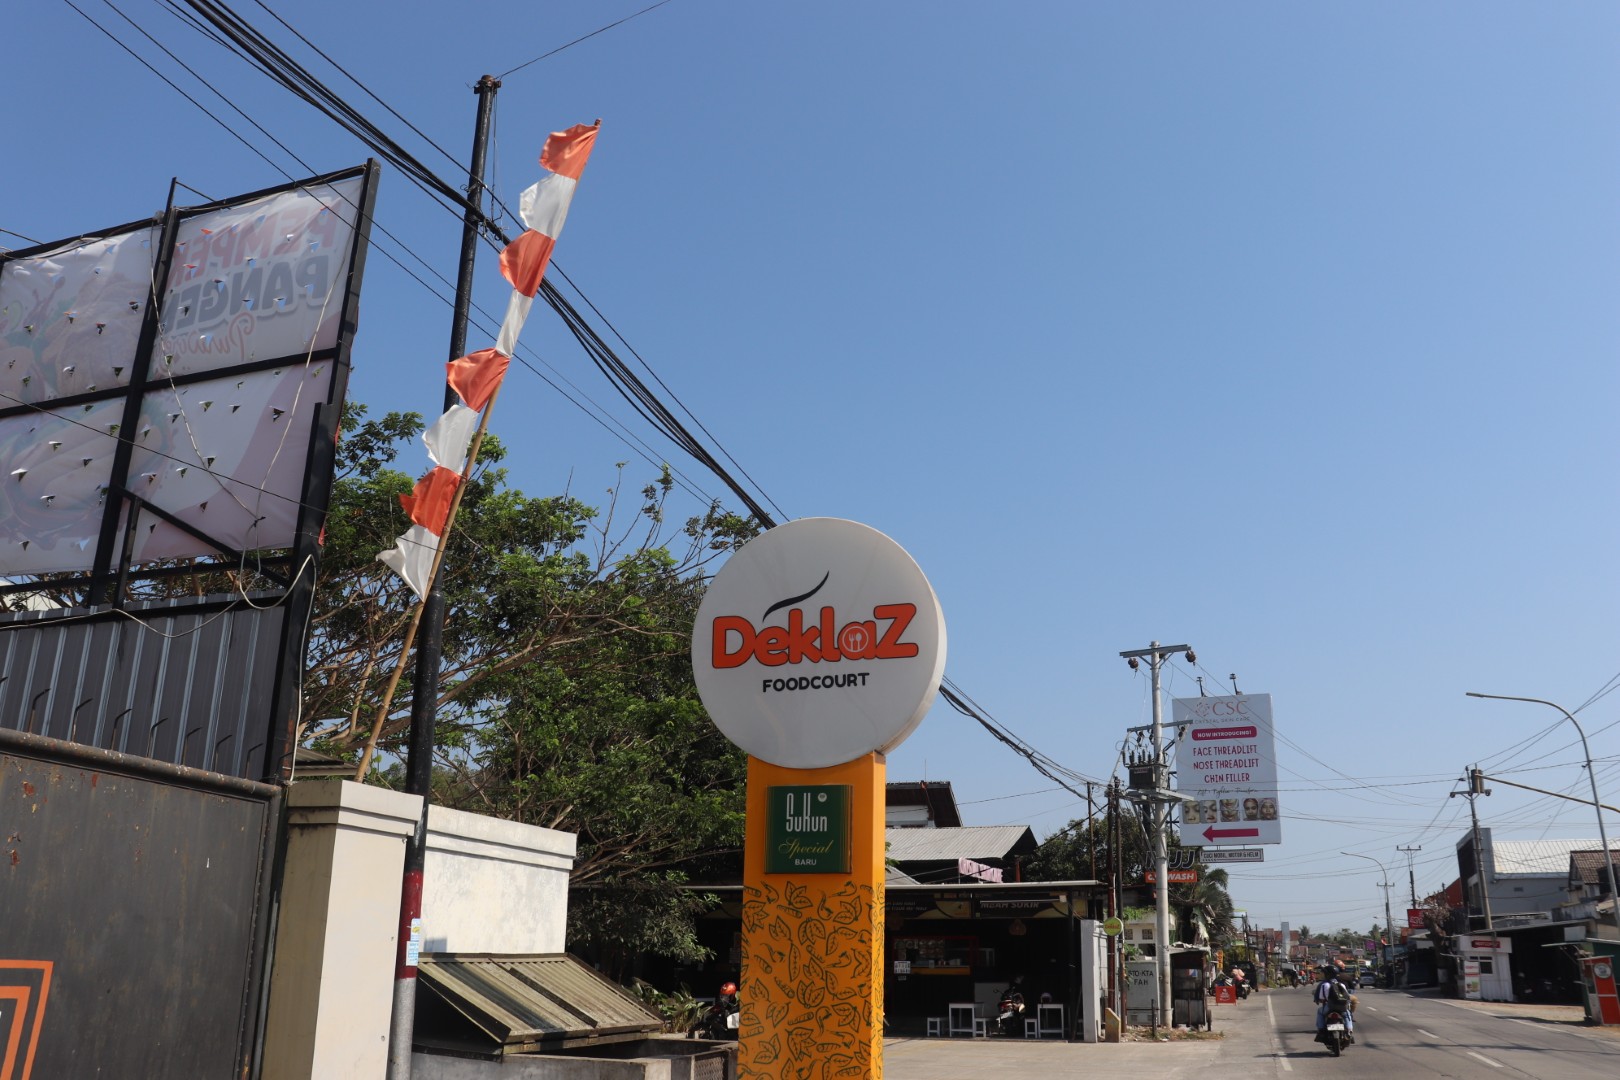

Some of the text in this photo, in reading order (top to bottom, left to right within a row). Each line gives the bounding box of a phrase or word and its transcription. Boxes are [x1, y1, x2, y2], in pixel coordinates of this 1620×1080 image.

[762, 672, 870, 693] FOODCOURT
[1212, 700, 1248, 716] CSC
[1193, 745, 1257, 757] FACE THREADLIFT
[1193, 758, 1259, 770] NOSE THREADLIFT
[1204, 772, 1250, 783] CHIN FILLER
[778, 838, 834, 859] Special
